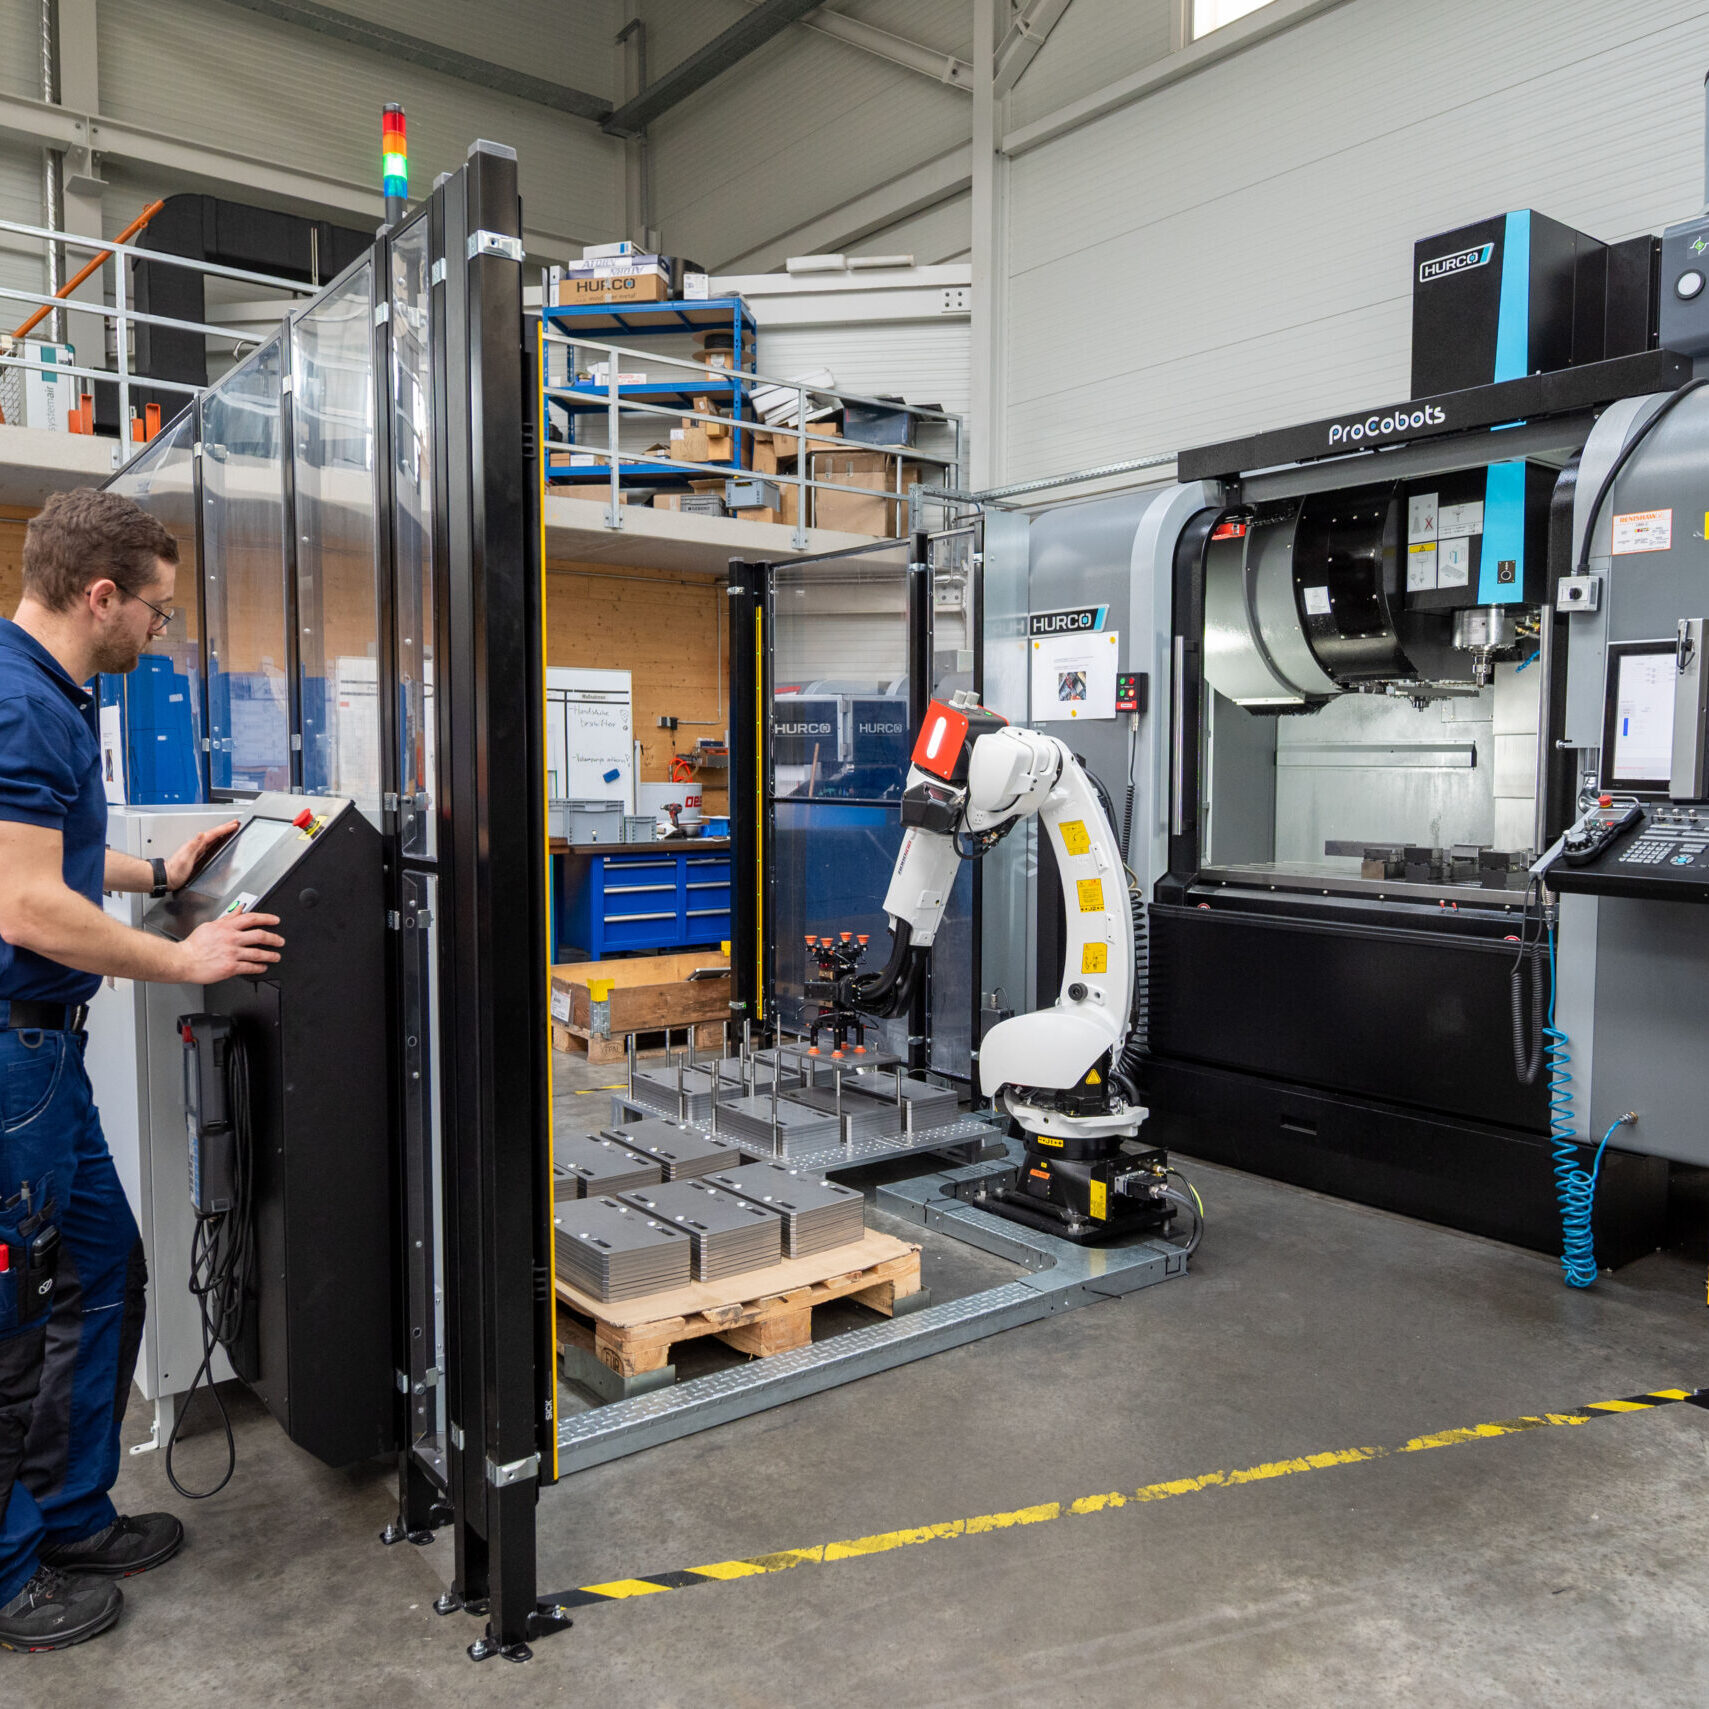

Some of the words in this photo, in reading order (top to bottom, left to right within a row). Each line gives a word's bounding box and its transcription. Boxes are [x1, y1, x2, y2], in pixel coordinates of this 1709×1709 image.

[1424, 252, 1479, 277] HURCO
[44, 385, 56, 432] systemair
[1033, 612, 1092, 632] HURCO
[774, 723, 831, 734] HURCO
[859, 723, 903, 734] HURCO
[545, 1399, 553, 1420] SICK
